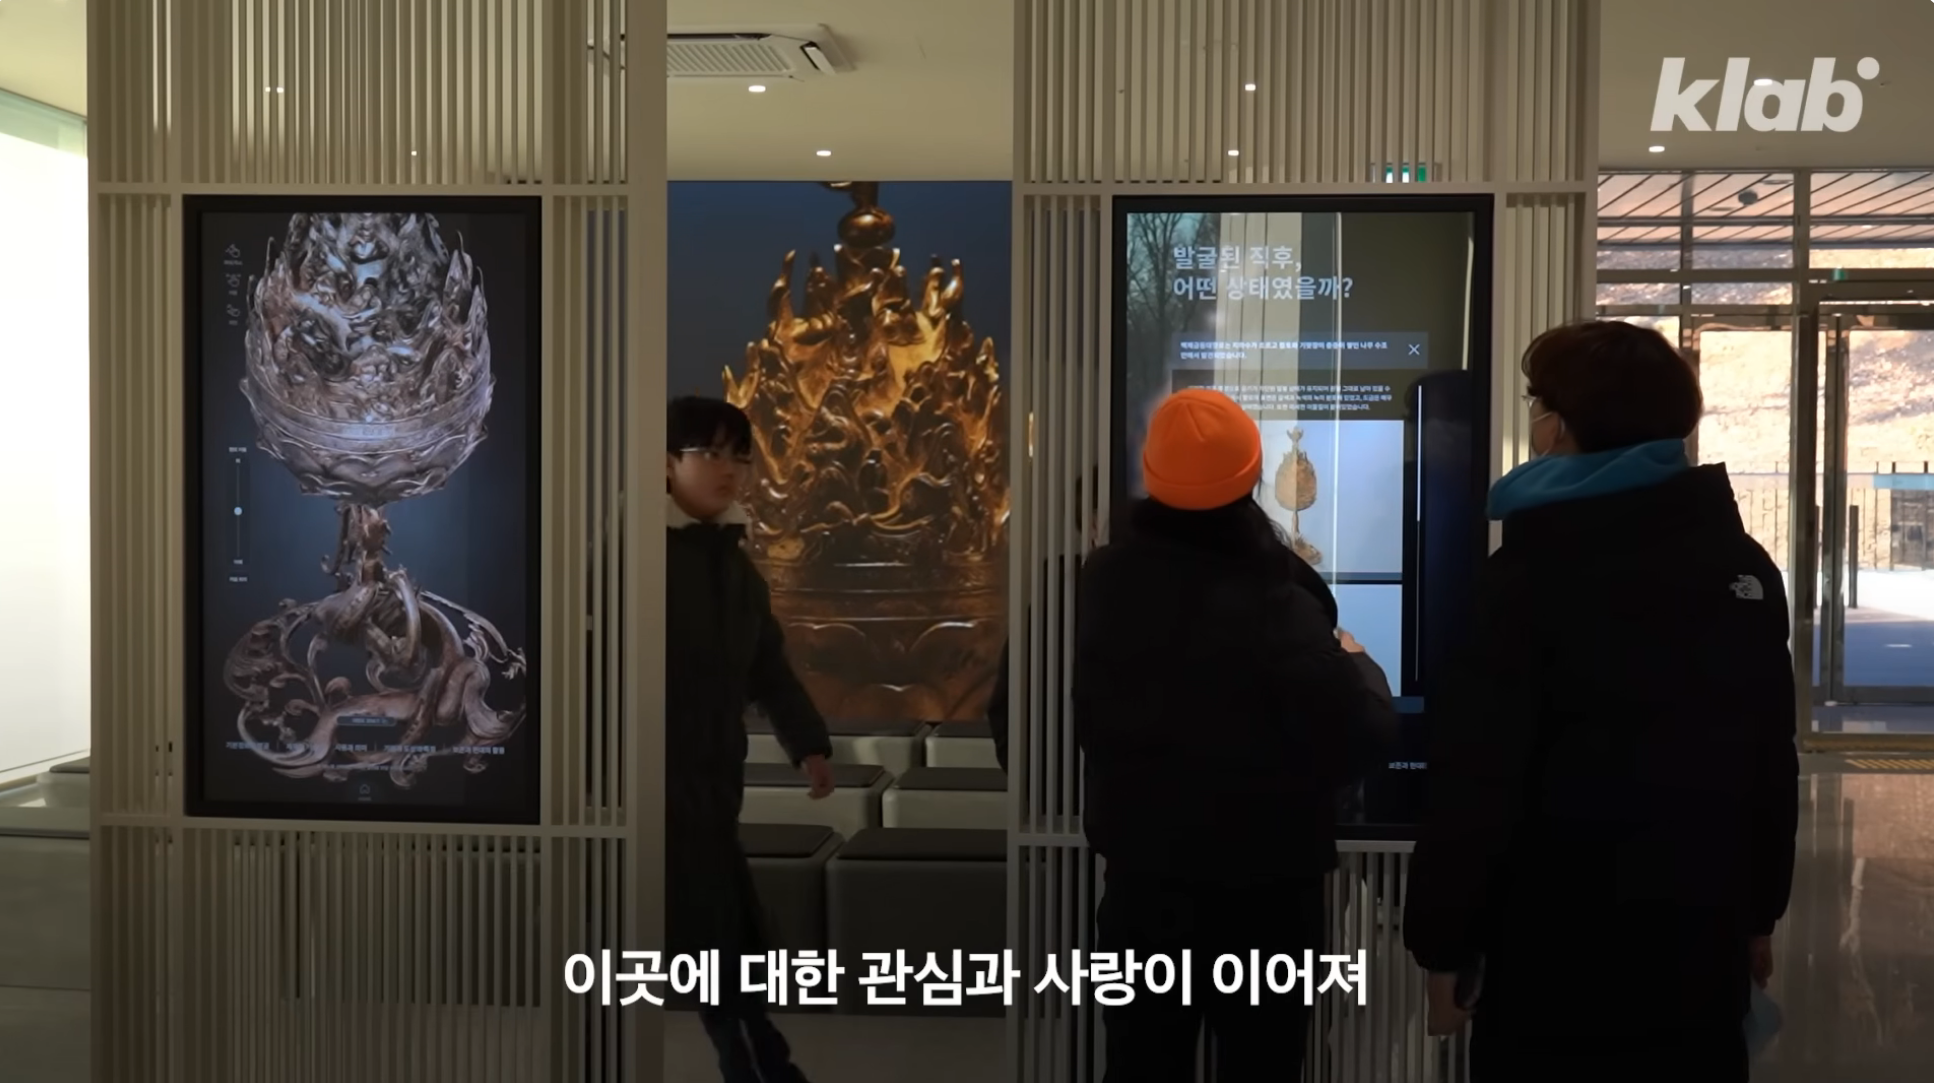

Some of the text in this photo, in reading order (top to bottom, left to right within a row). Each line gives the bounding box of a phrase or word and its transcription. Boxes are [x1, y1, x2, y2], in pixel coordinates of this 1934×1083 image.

[1173, 245, 1301, 273] 발굴된 직후,
[1173, 276, 1353, 300] 어떤 상태였을까?
[1360, 341, 1374, 350] 나무
[1374, 341, 1388, 350] 수조
